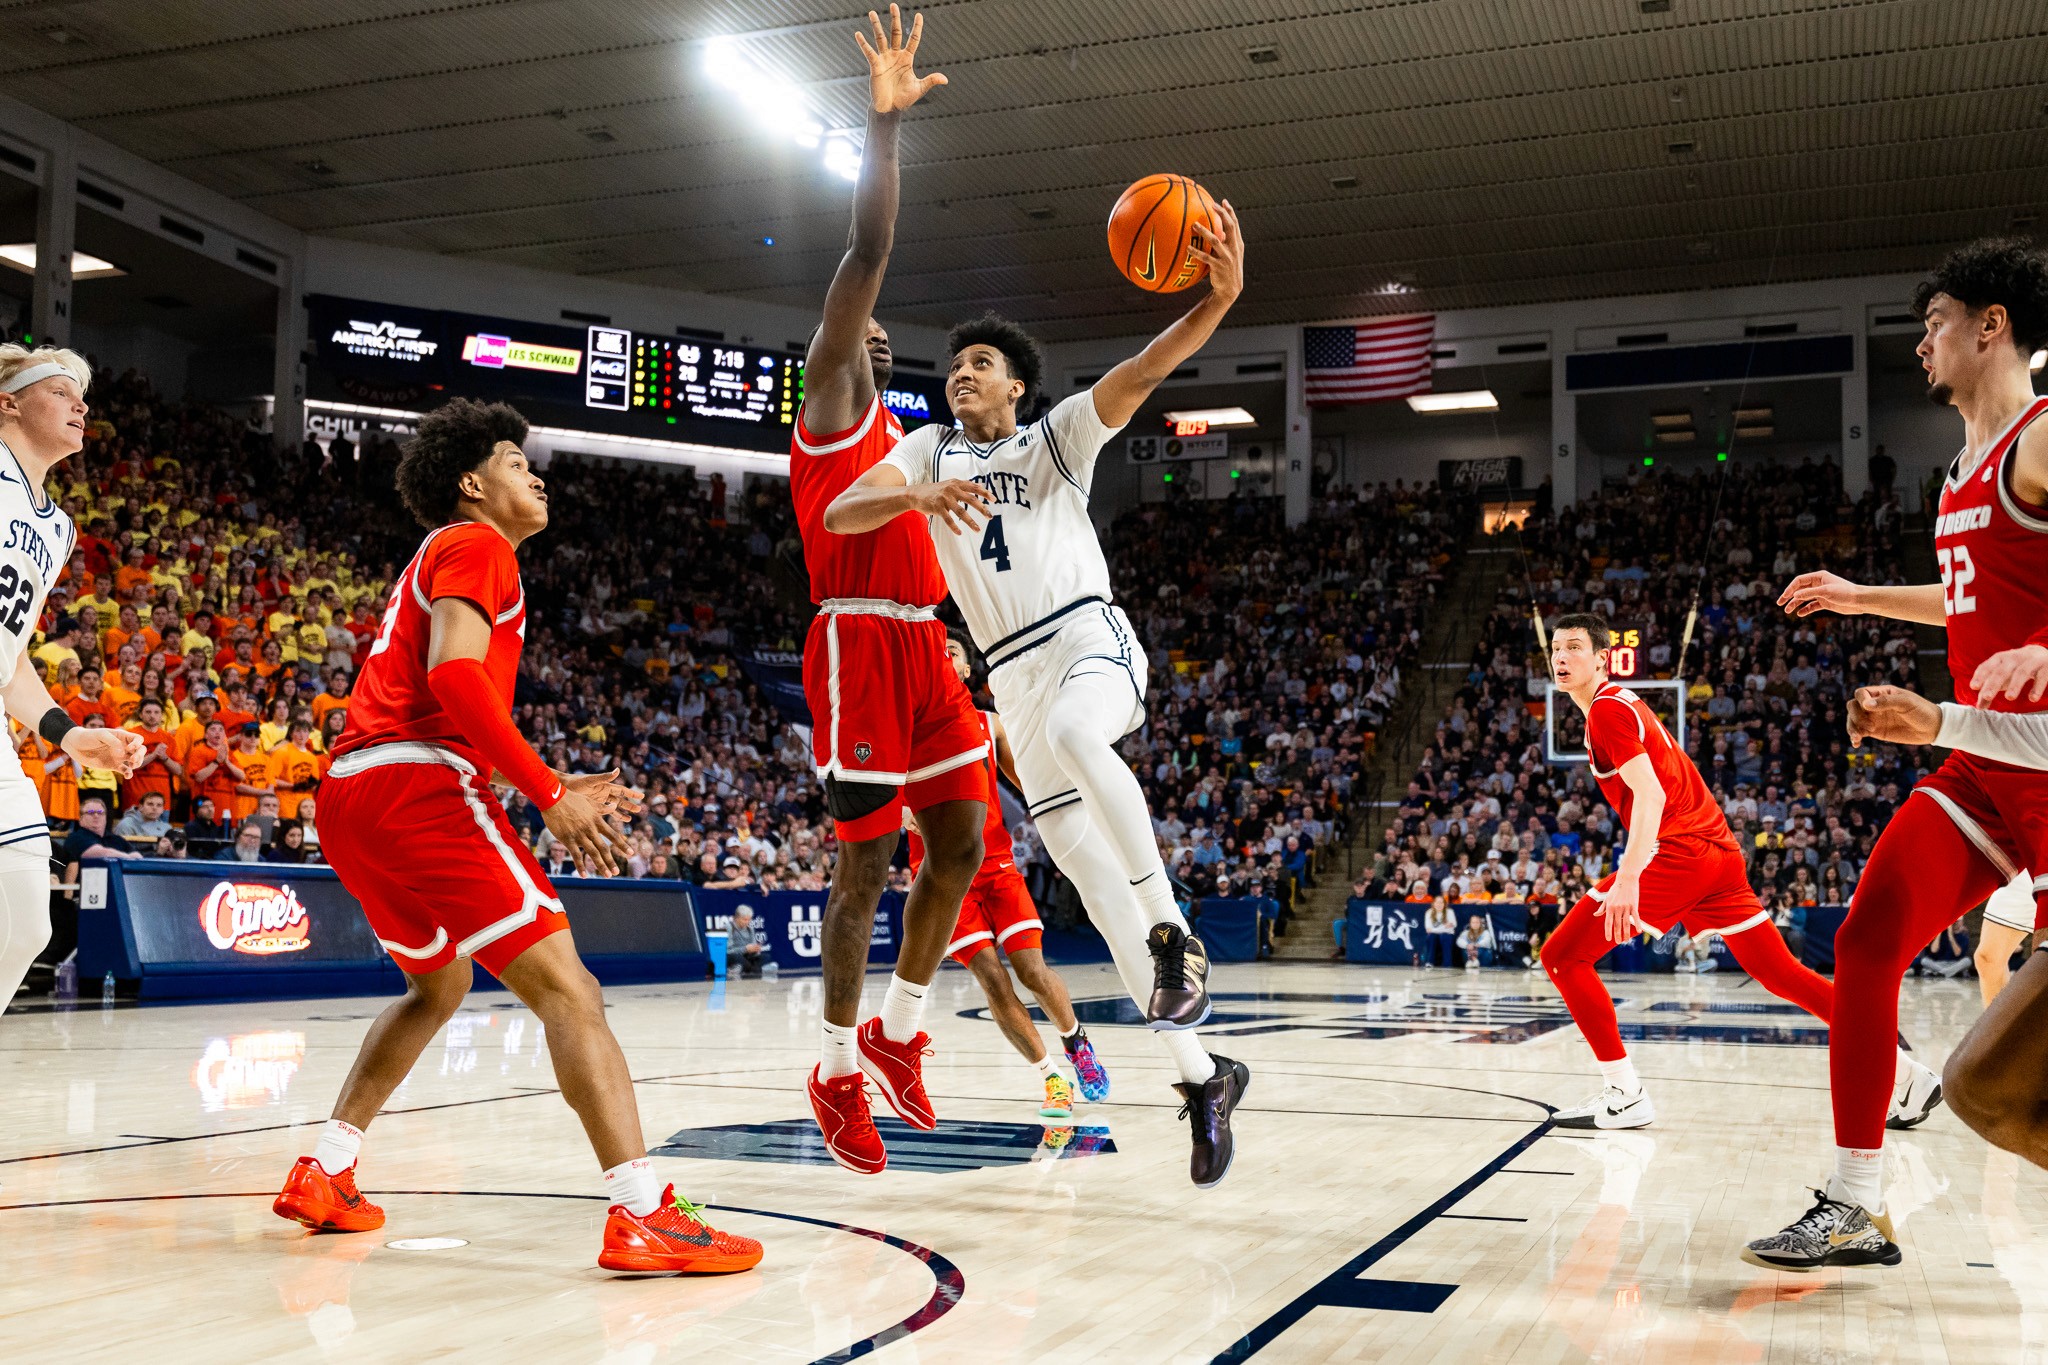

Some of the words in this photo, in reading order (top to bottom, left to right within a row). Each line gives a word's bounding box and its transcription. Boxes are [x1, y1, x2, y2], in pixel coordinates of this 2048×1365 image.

[54, 300, 67, 317] N
[331, 330, 396, 351] AMERICA
[395, 338, 439, 356] FIRST
[508, 349, 527, 360] LES
[1849, 426, 1861, 440] S
[1558, 444, 1569, 458] S
[1291, 459, 1302, 472] R
[960, 471, 1032, 515] TATE
[979, 513, 1012, 573] 4
[1936, 545, 1977, 617] 22
[0, 563, 34, 637] 22
[205, 881, 307, 950] Cane's
